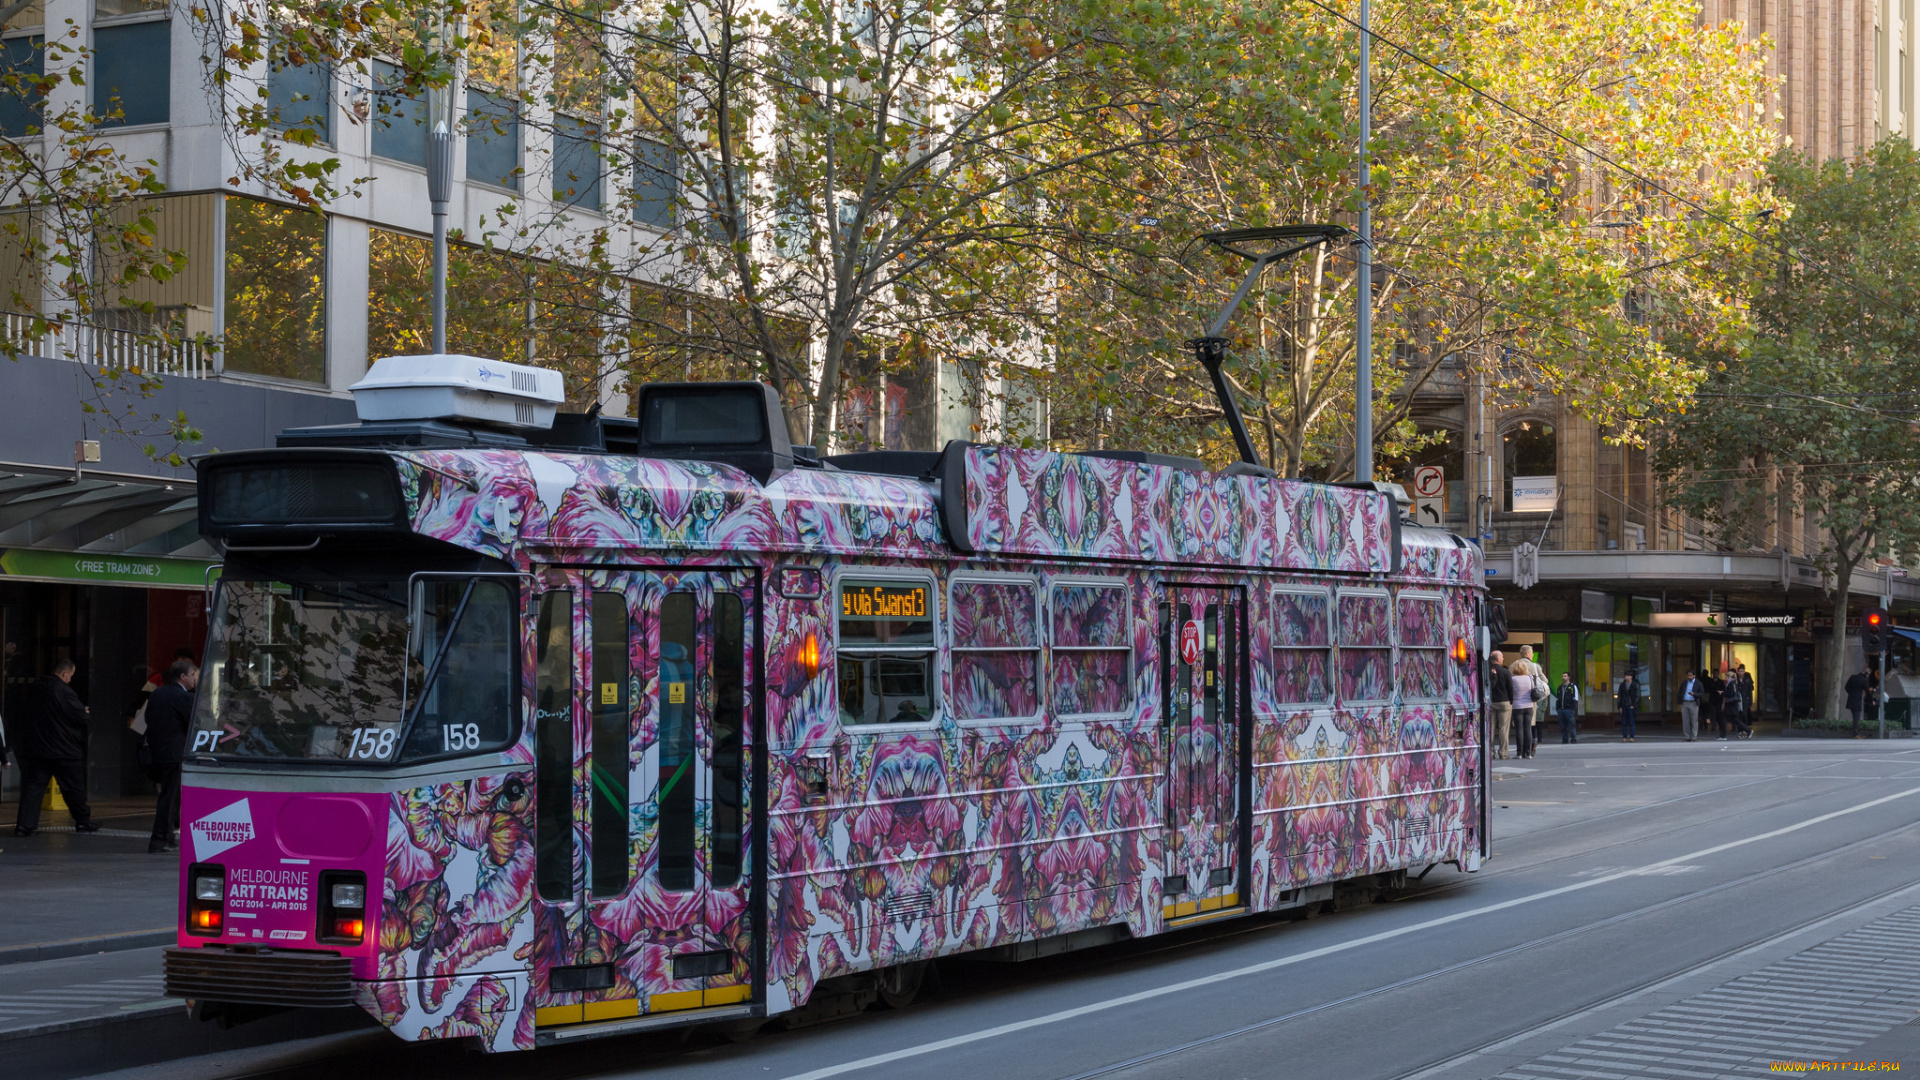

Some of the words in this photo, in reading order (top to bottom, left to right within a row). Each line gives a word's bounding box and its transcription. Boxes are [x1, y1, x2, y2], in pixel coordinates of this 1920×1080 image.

[1140, 218, 1158, 226] 208
[81, 560, 104, 573] FREE
[106, 562, 131, 574] TRAM
[132, 563, 154, 575] ZONE
[853, 587, 872, 616] via
[1731, 616, 1758, 624] TRAVEL
[1758, 616, 1784, 624] MONEY
[1184, 627, 1197, 638] STOP
[348, 727, 397, 759] 158
[442, 722, 481, 751] 158
[193, 821, 251, 833] MELBOURNE
[205, 832, 250, 842] FESTIVAL
[230, 868, 309, 885] MELBOURNE
[229, 884, 257, 899] ART
[259, 885, 309, 901] TRAMS
[230, 899, 245, 908] OCT
[246, 900, 264, 909] 2014
[271, 901, 288, 910] APR
[288, 902, 308, 911] 2015
